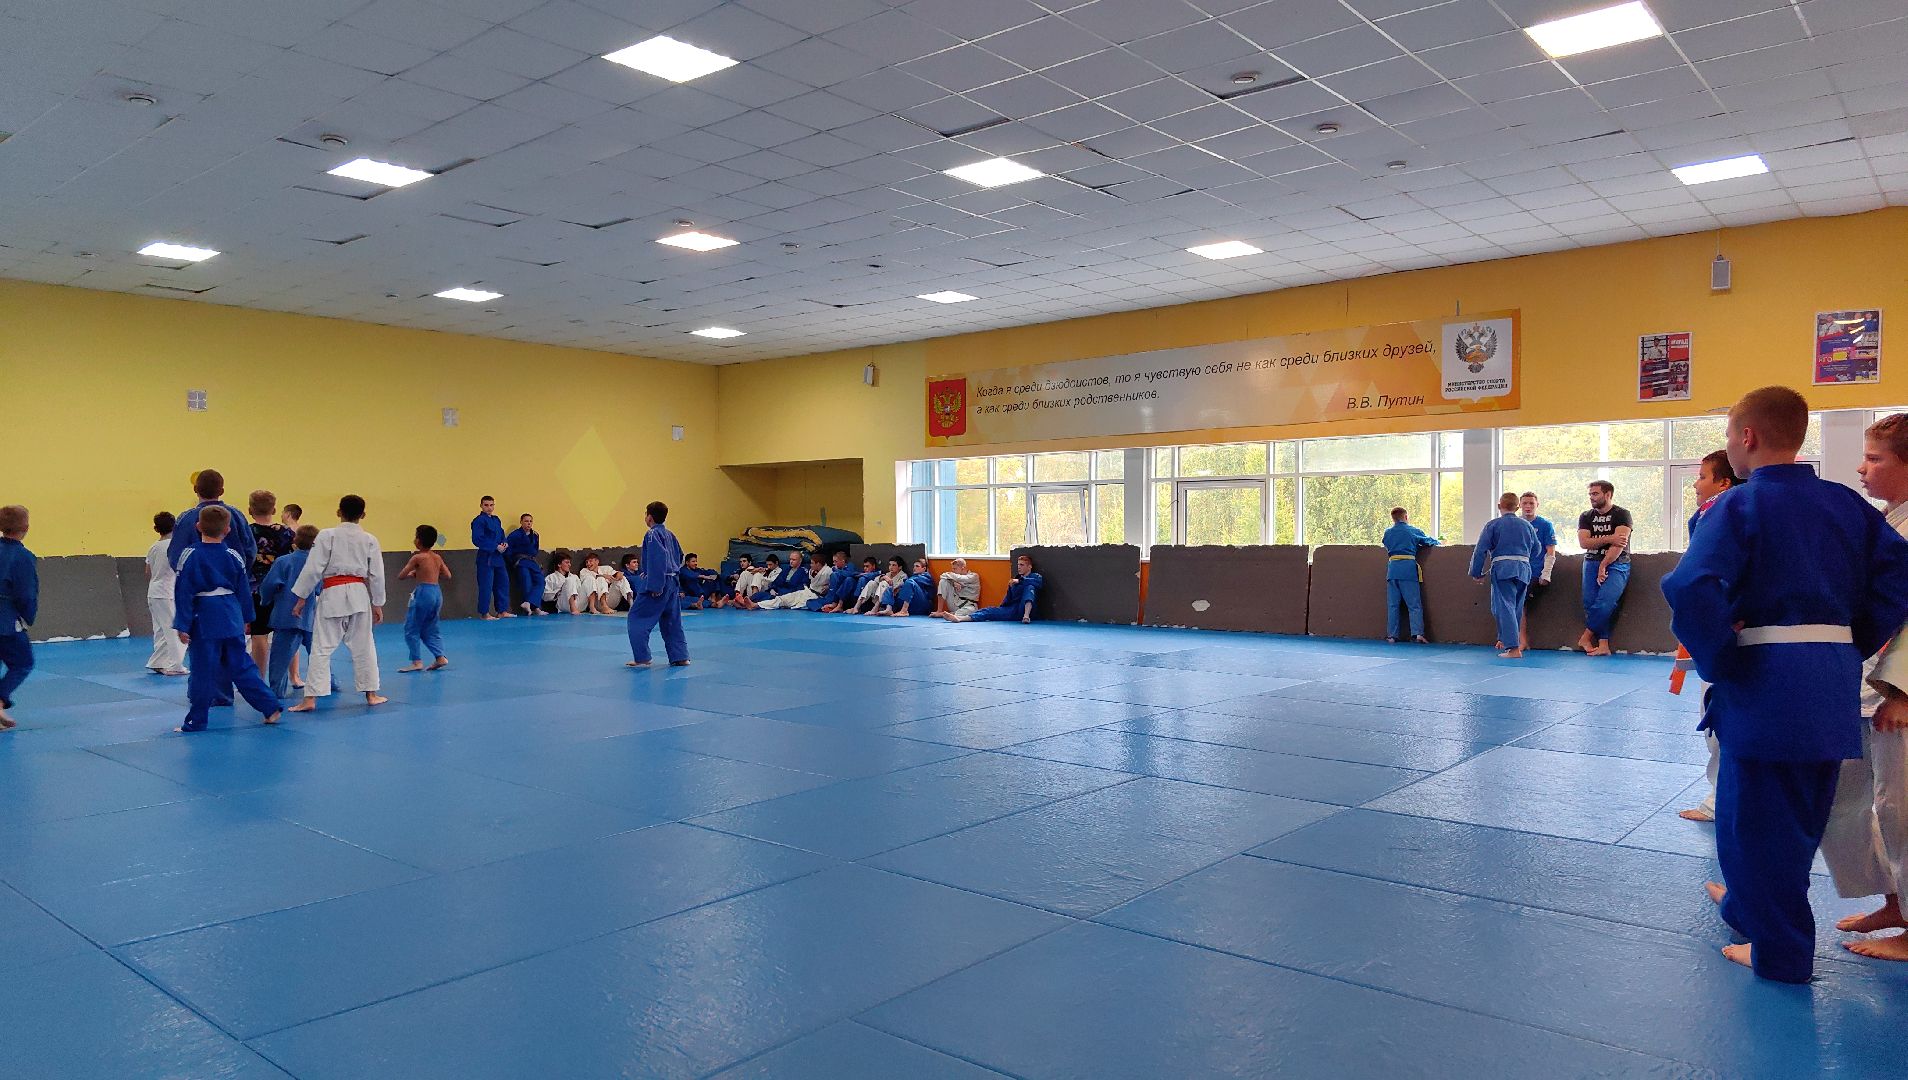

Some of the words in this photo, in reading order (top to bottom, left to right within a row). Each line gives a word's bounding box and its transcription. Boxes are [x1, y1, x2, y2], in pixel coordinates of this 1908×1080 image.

[976, 386, 1004, 398] Когда
[1006, 386, 1012, 395] я
[1014, 381, 1043, 396] среди
[1115, 373, 1131, 384] то
[1134, 372, 1141, 382] я
[1144, 366, 1201, 383] чувствую
[1204, 361, 1233, 375] себя
[1236, 360, 1251, 372] не
[1254, 356, 1277, 370] как
[1280, 352, 1319, 369] среди
[1323, 348, 1378, 363] близких
[1382, 340, 1437, 359] друзей,
[976, 406, 983, 415] а
[984, 404, 1000, 414] как
[1002, 400, 1030, 414] среди
[1032, 398, 1071, 410] близких
[1073, 390, 1160, 409] родственников.
[1377, 394, 1425, 410] Путин
[1592, 515, 1612, 523] ARE
[1592, 524, 1612, 533] YOU
